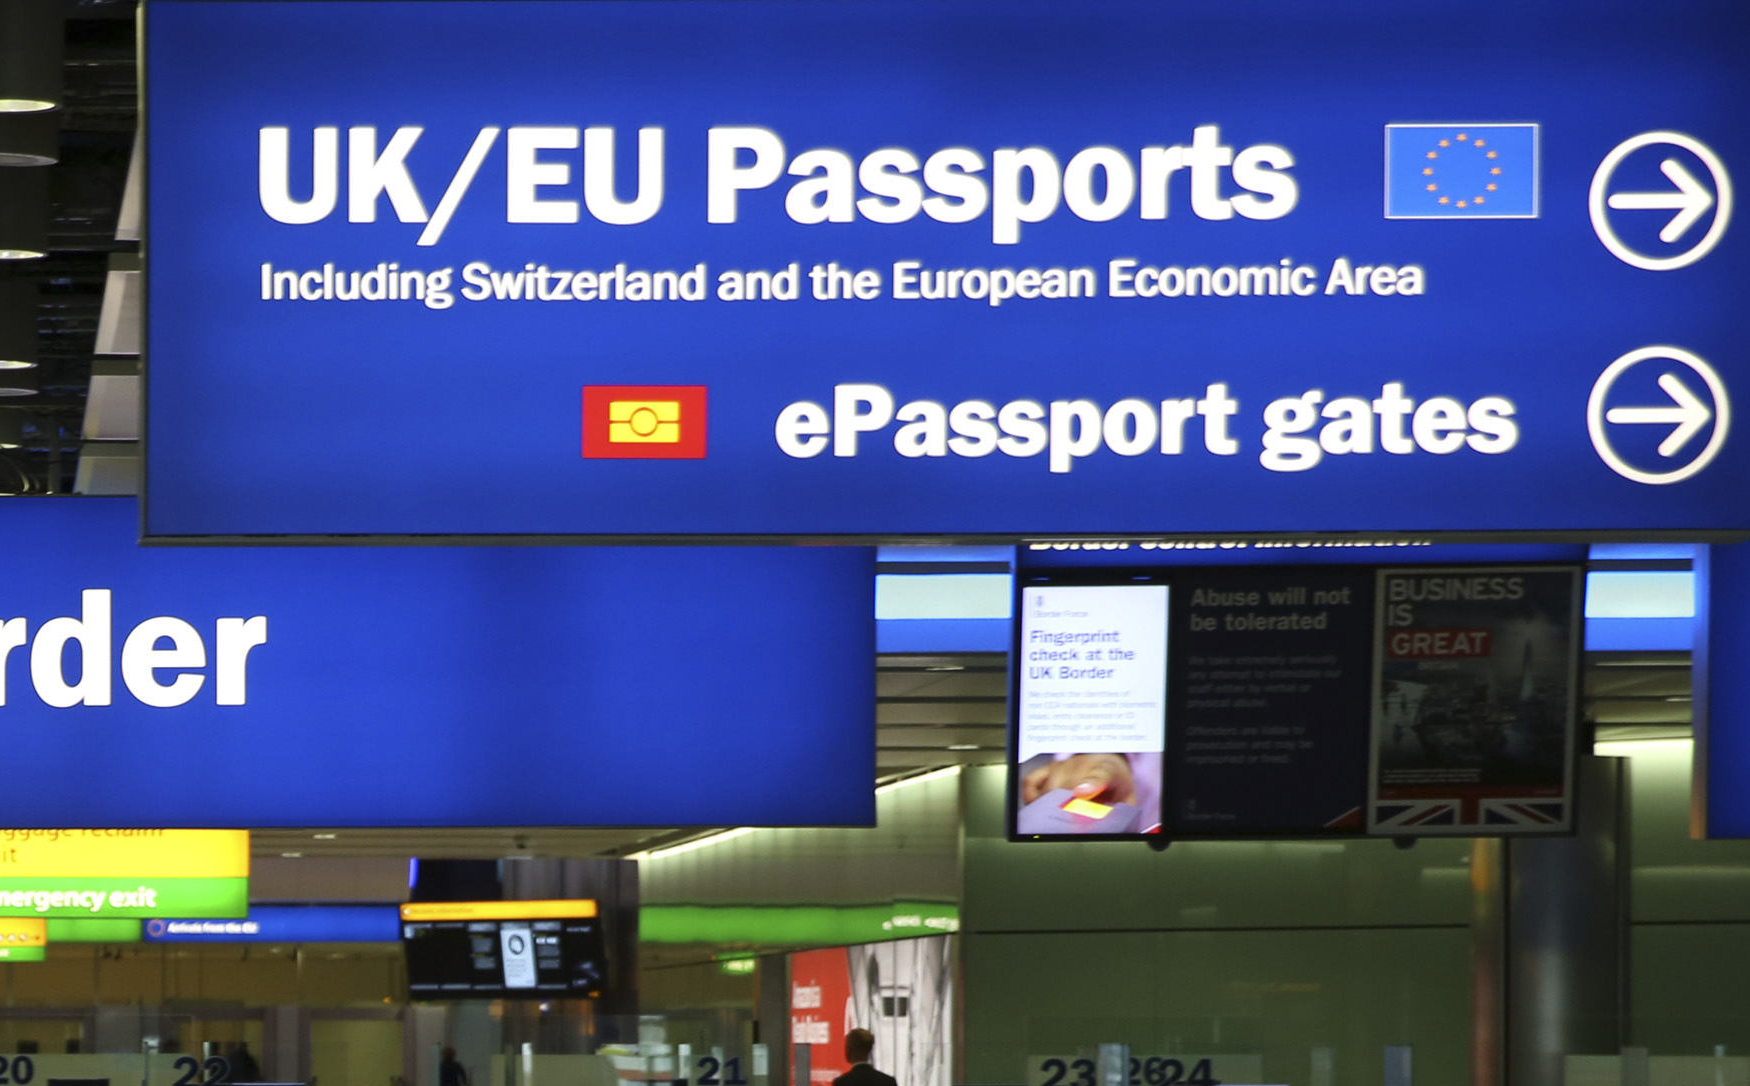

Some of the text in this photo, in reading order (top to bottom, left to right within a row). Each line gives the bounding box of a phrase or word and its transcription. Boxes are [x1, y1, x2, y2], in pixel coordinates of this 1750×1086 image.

[259, 125, 1298, 246] UK/EU Passports
[262, 258, 1424, 309] Including Switzerland and the European Economic Area
[775, 382, 1518, 474] ePassport gates
[1190, 587, 1351, 607] Abuse will not
[1389, 577, 1524, 602] BUSINESS
[1190, 611, 1328, 631] be tolerated
[1387, 603, 1413, 627] IS
[1029, 630, 1120, 646] Fingerprint
[1391, 632, 1490, 656] GREAT
[1029, 649, 1135, 661] check at the
[1029, 666, 1114, 679] UK Border
[109, 886, 157, 908] exit
[697, 1056, 748, 1086] 21
[1128, 1057, 1167, 1086] 26
